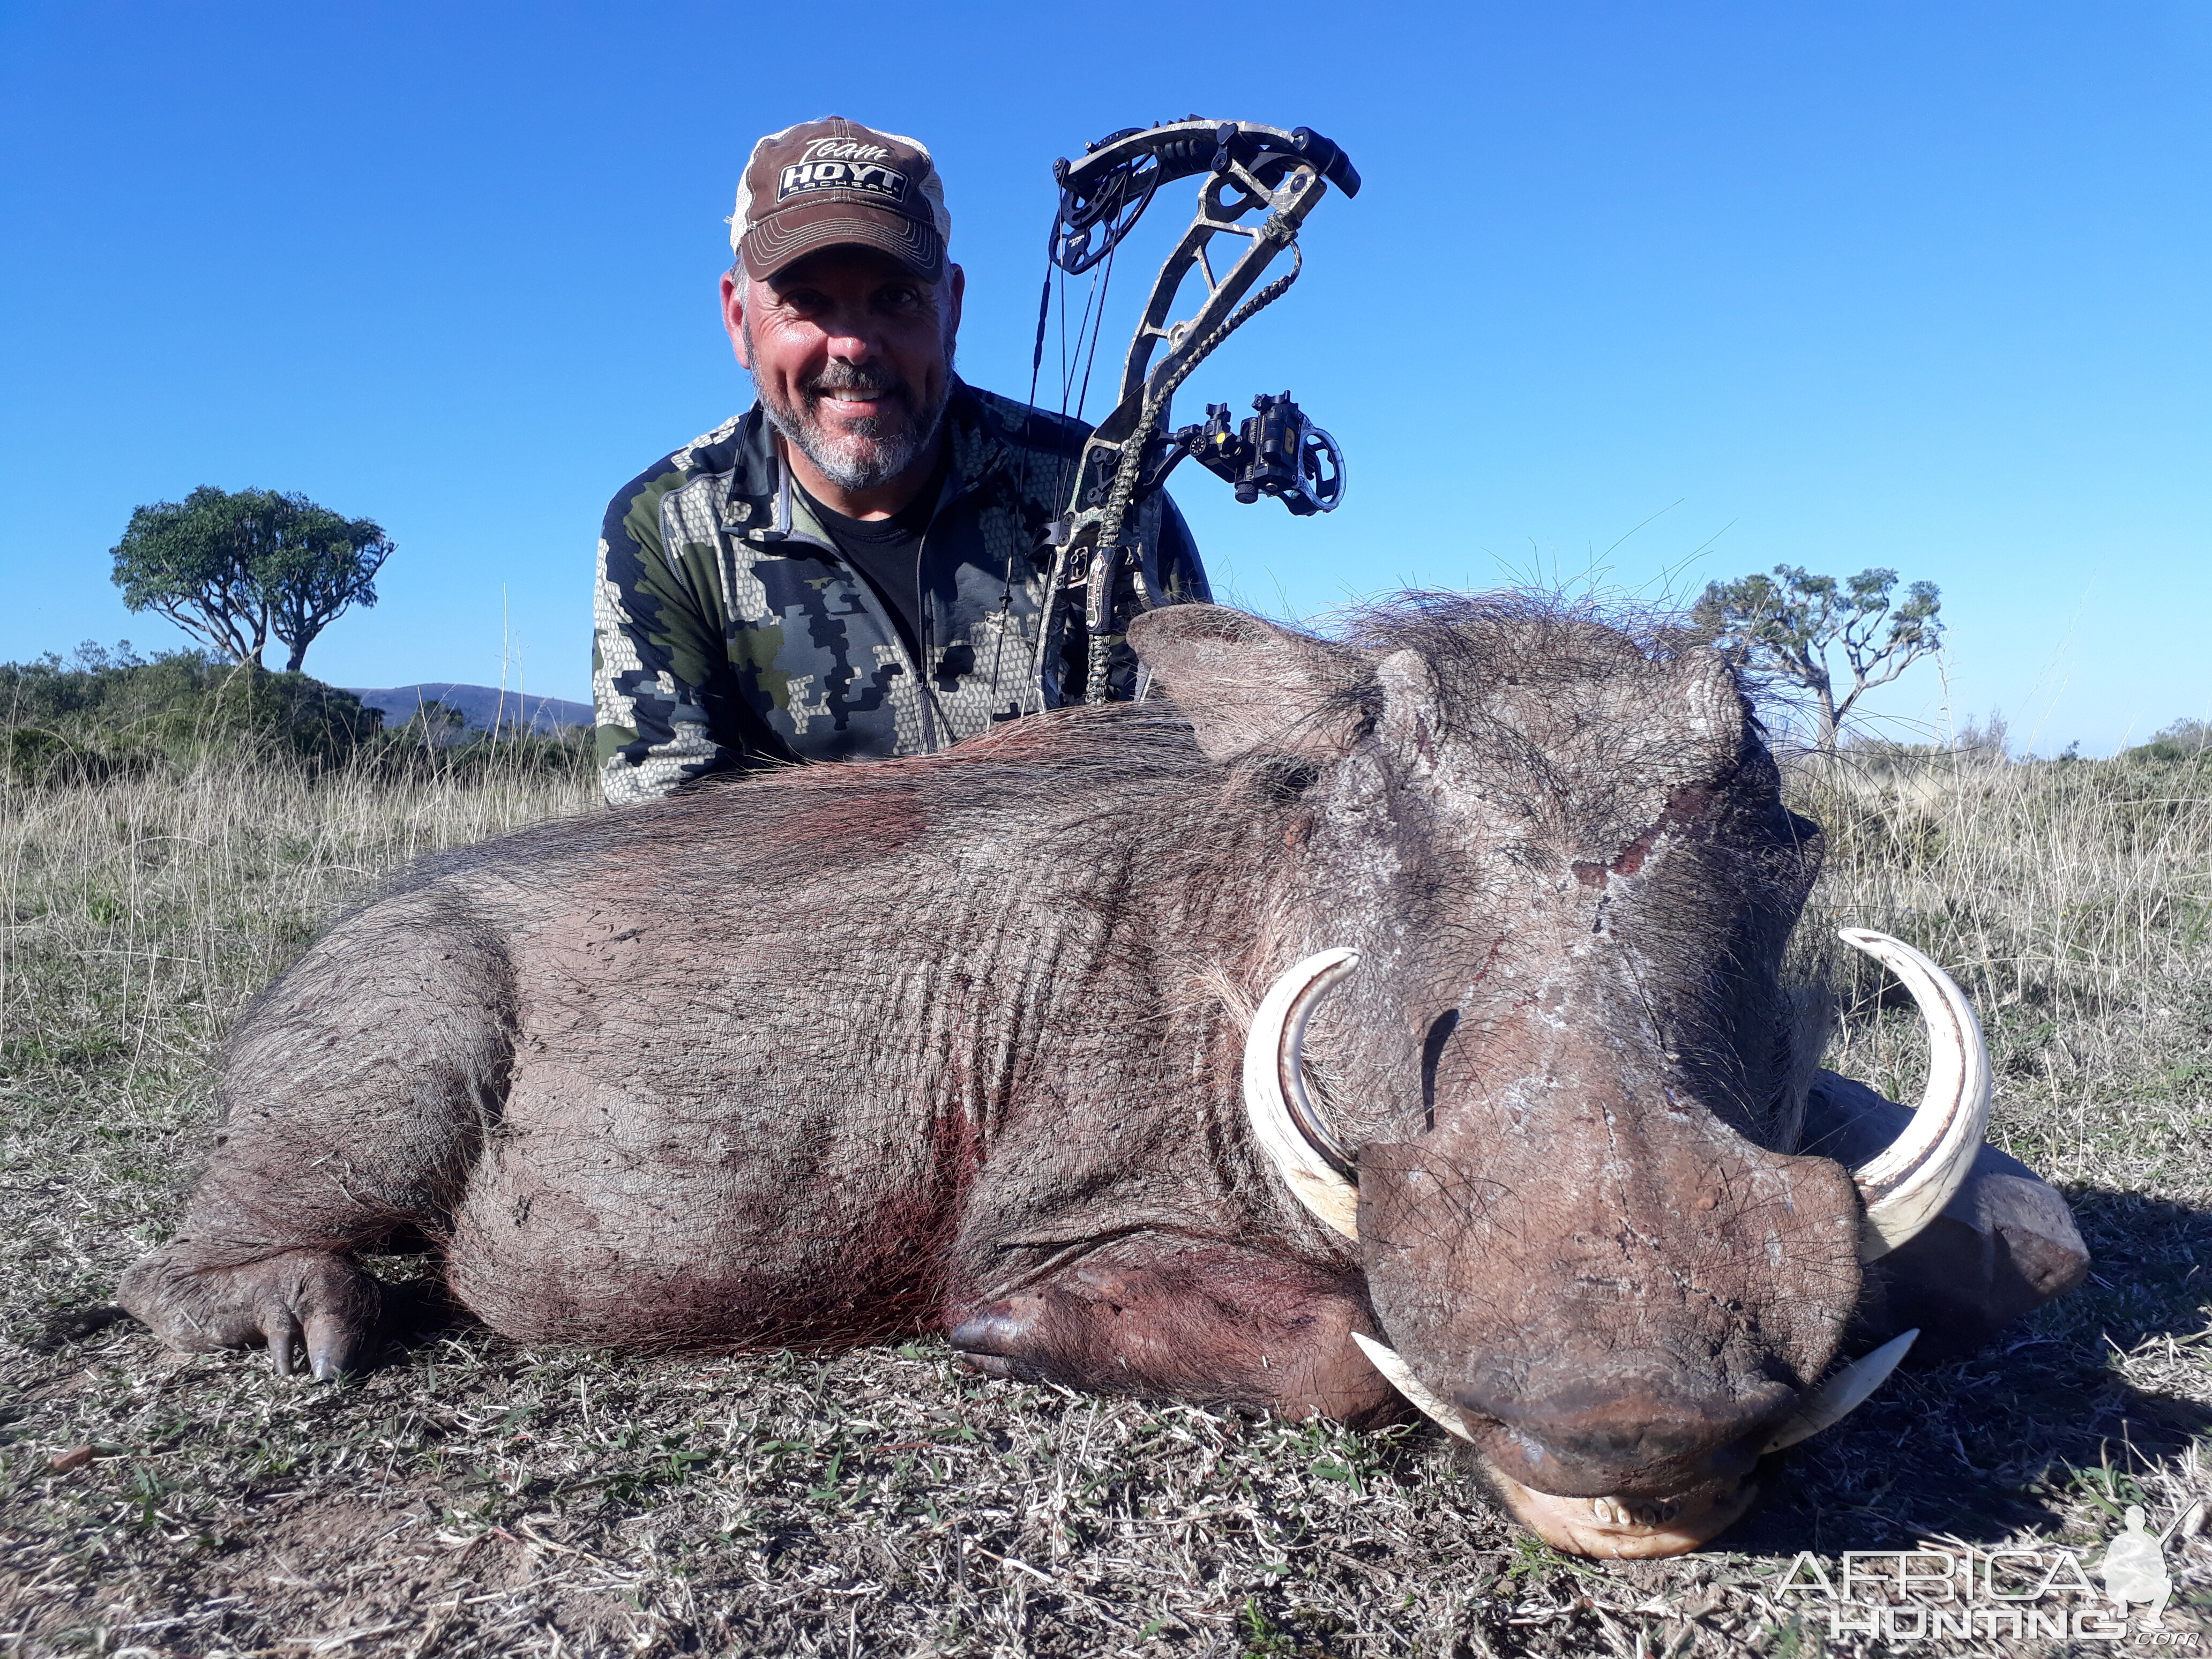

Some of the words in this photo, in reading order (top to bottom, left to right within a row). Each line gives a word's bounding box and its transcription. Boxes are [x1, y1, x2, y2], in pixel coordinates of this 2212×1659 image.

[798, 137, 890, 166] Team
[783, 163, 904, 188] HOYT
[789, 180, 893, 194] ARCHERY
